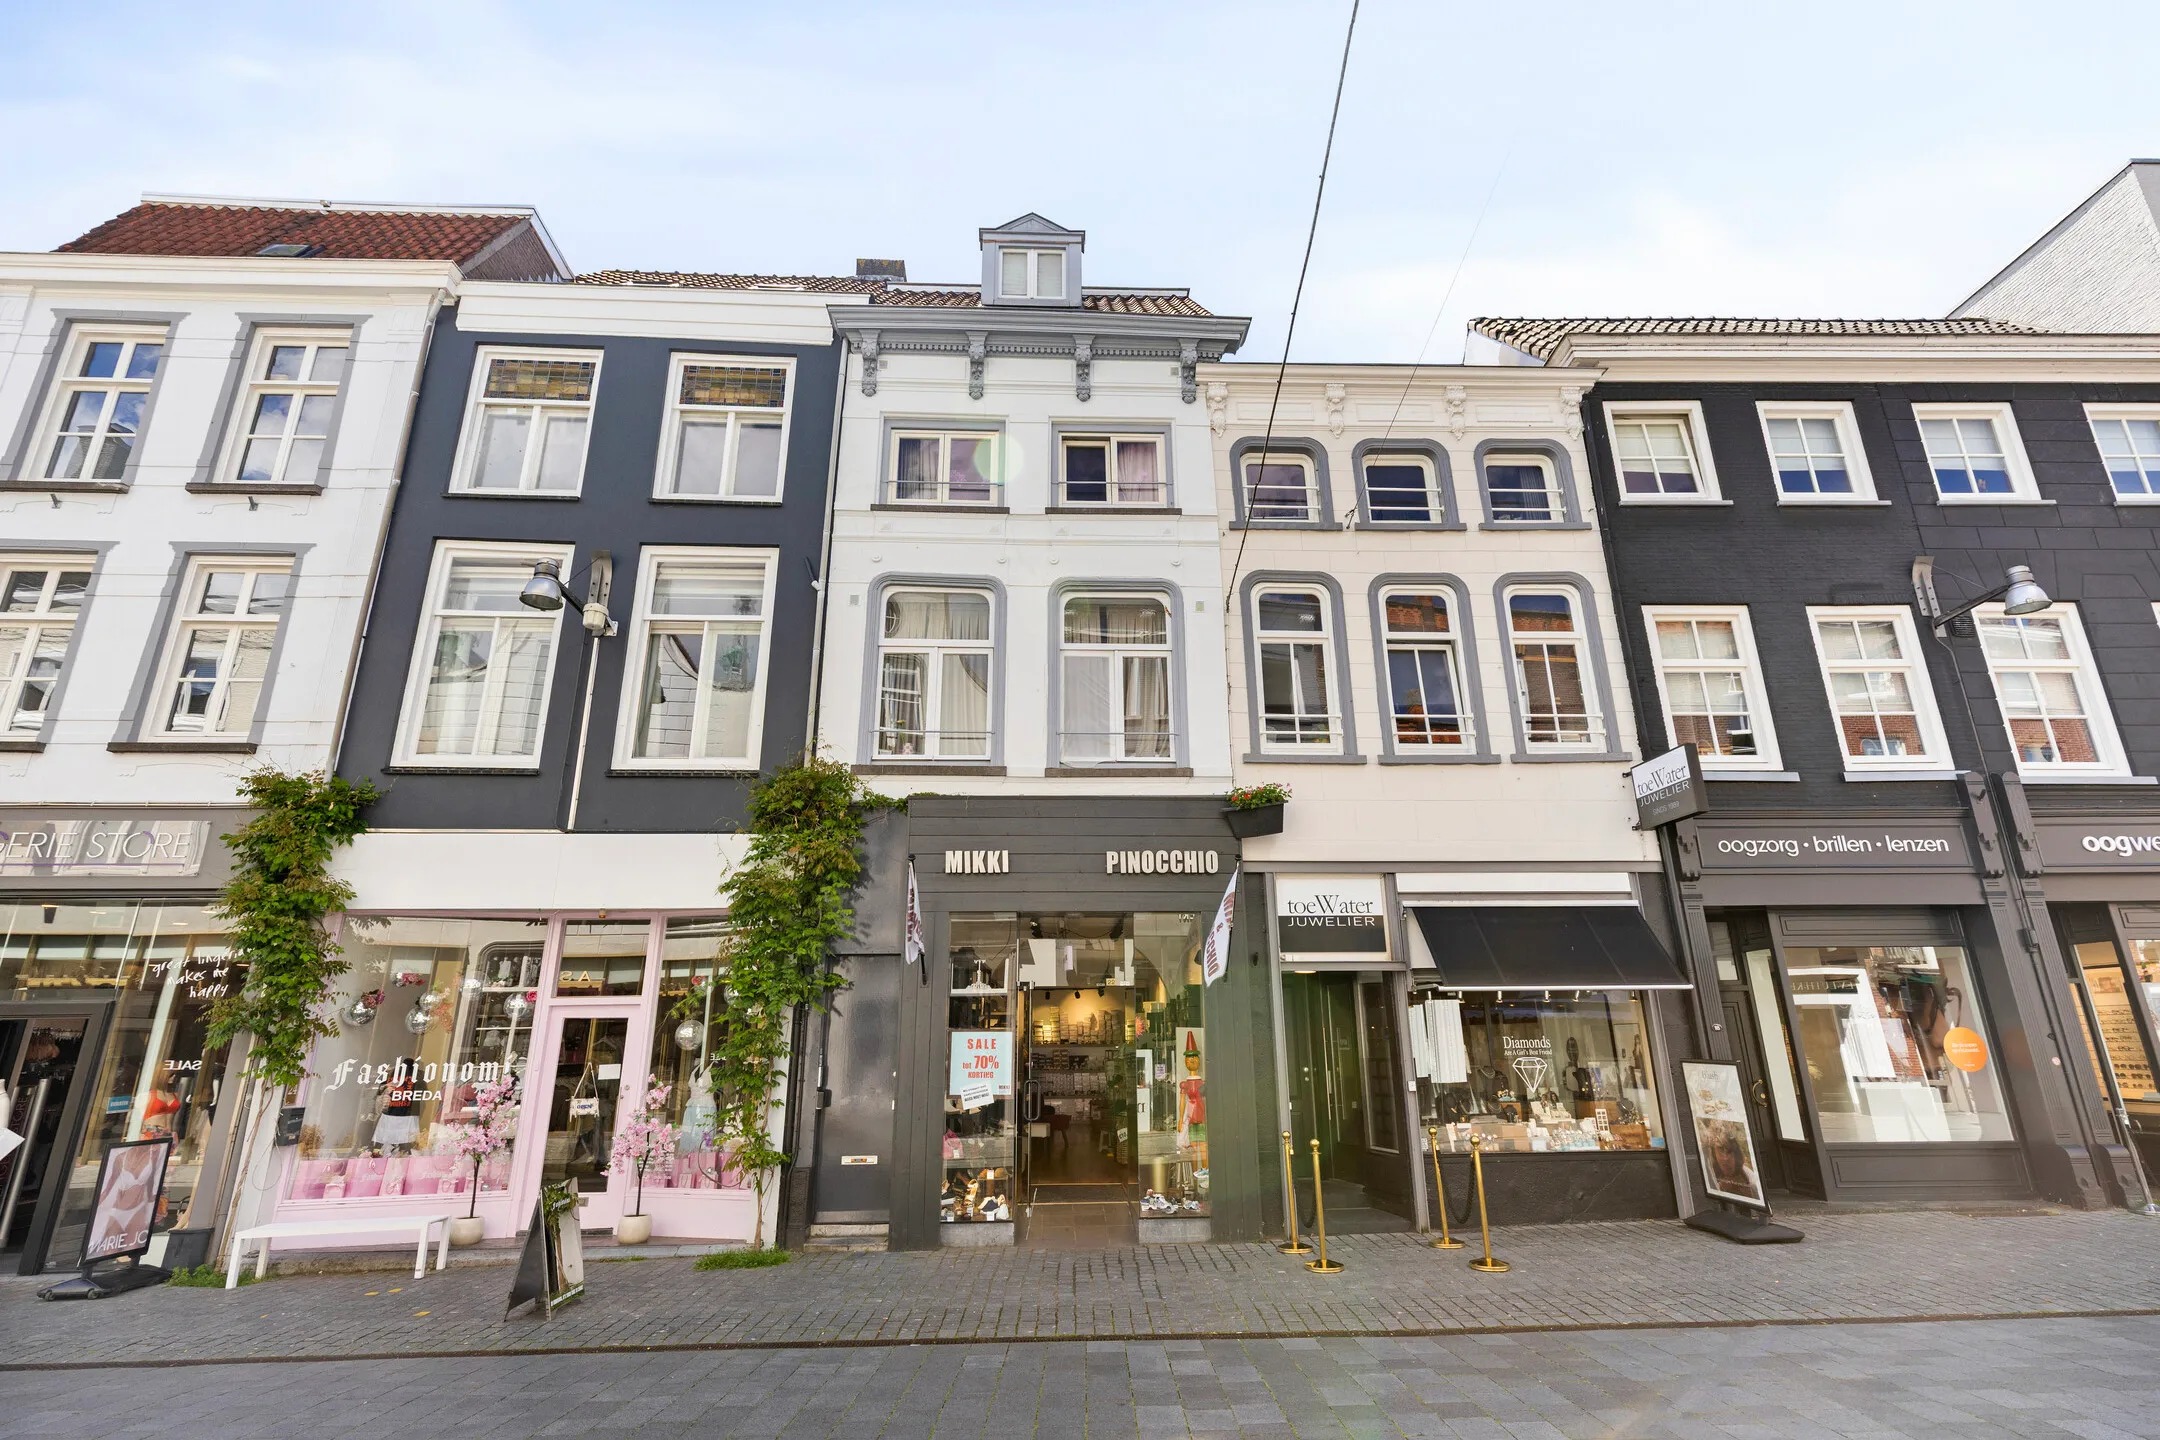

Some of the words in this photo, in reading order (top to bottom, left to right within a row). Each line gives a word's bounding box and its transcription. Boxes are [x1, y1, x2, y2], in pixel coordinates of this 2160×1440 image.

[1637, 765, 1686, 796] toeWater
[1640, 780, 1690, 807] JUWELIER
[86, 830, 193, 858] STORE
[1718, 838, 1800, 857] oogzorg
[1812, 834, 1873, 852] brillen
[1885, 834, 1950, 852] lenzen
[945, 850, 1009, 873] MIKKI
[1106, 850, 1219, 874] PINOCCHIO
[1287, 894, 1374, 914] toeWater
[1287, 916, 1376, 927] JUWELIER
[152, 955, 191, 978] great
[166, 969, 207, 985] makes
[213, 967, 229, 978] me
[189, 983, 229, 998] happy
[967, 1038, 997, 1050] SALE
[1503, 1035, 1551, 1049] Diamonds
[974, 1055, 999, 1070] 70%
[967, 1071, 994, 1079] KORTING
[391, 1090, 442, 1101] BREDA
[87, 1233, 128, 1254] MARIE
